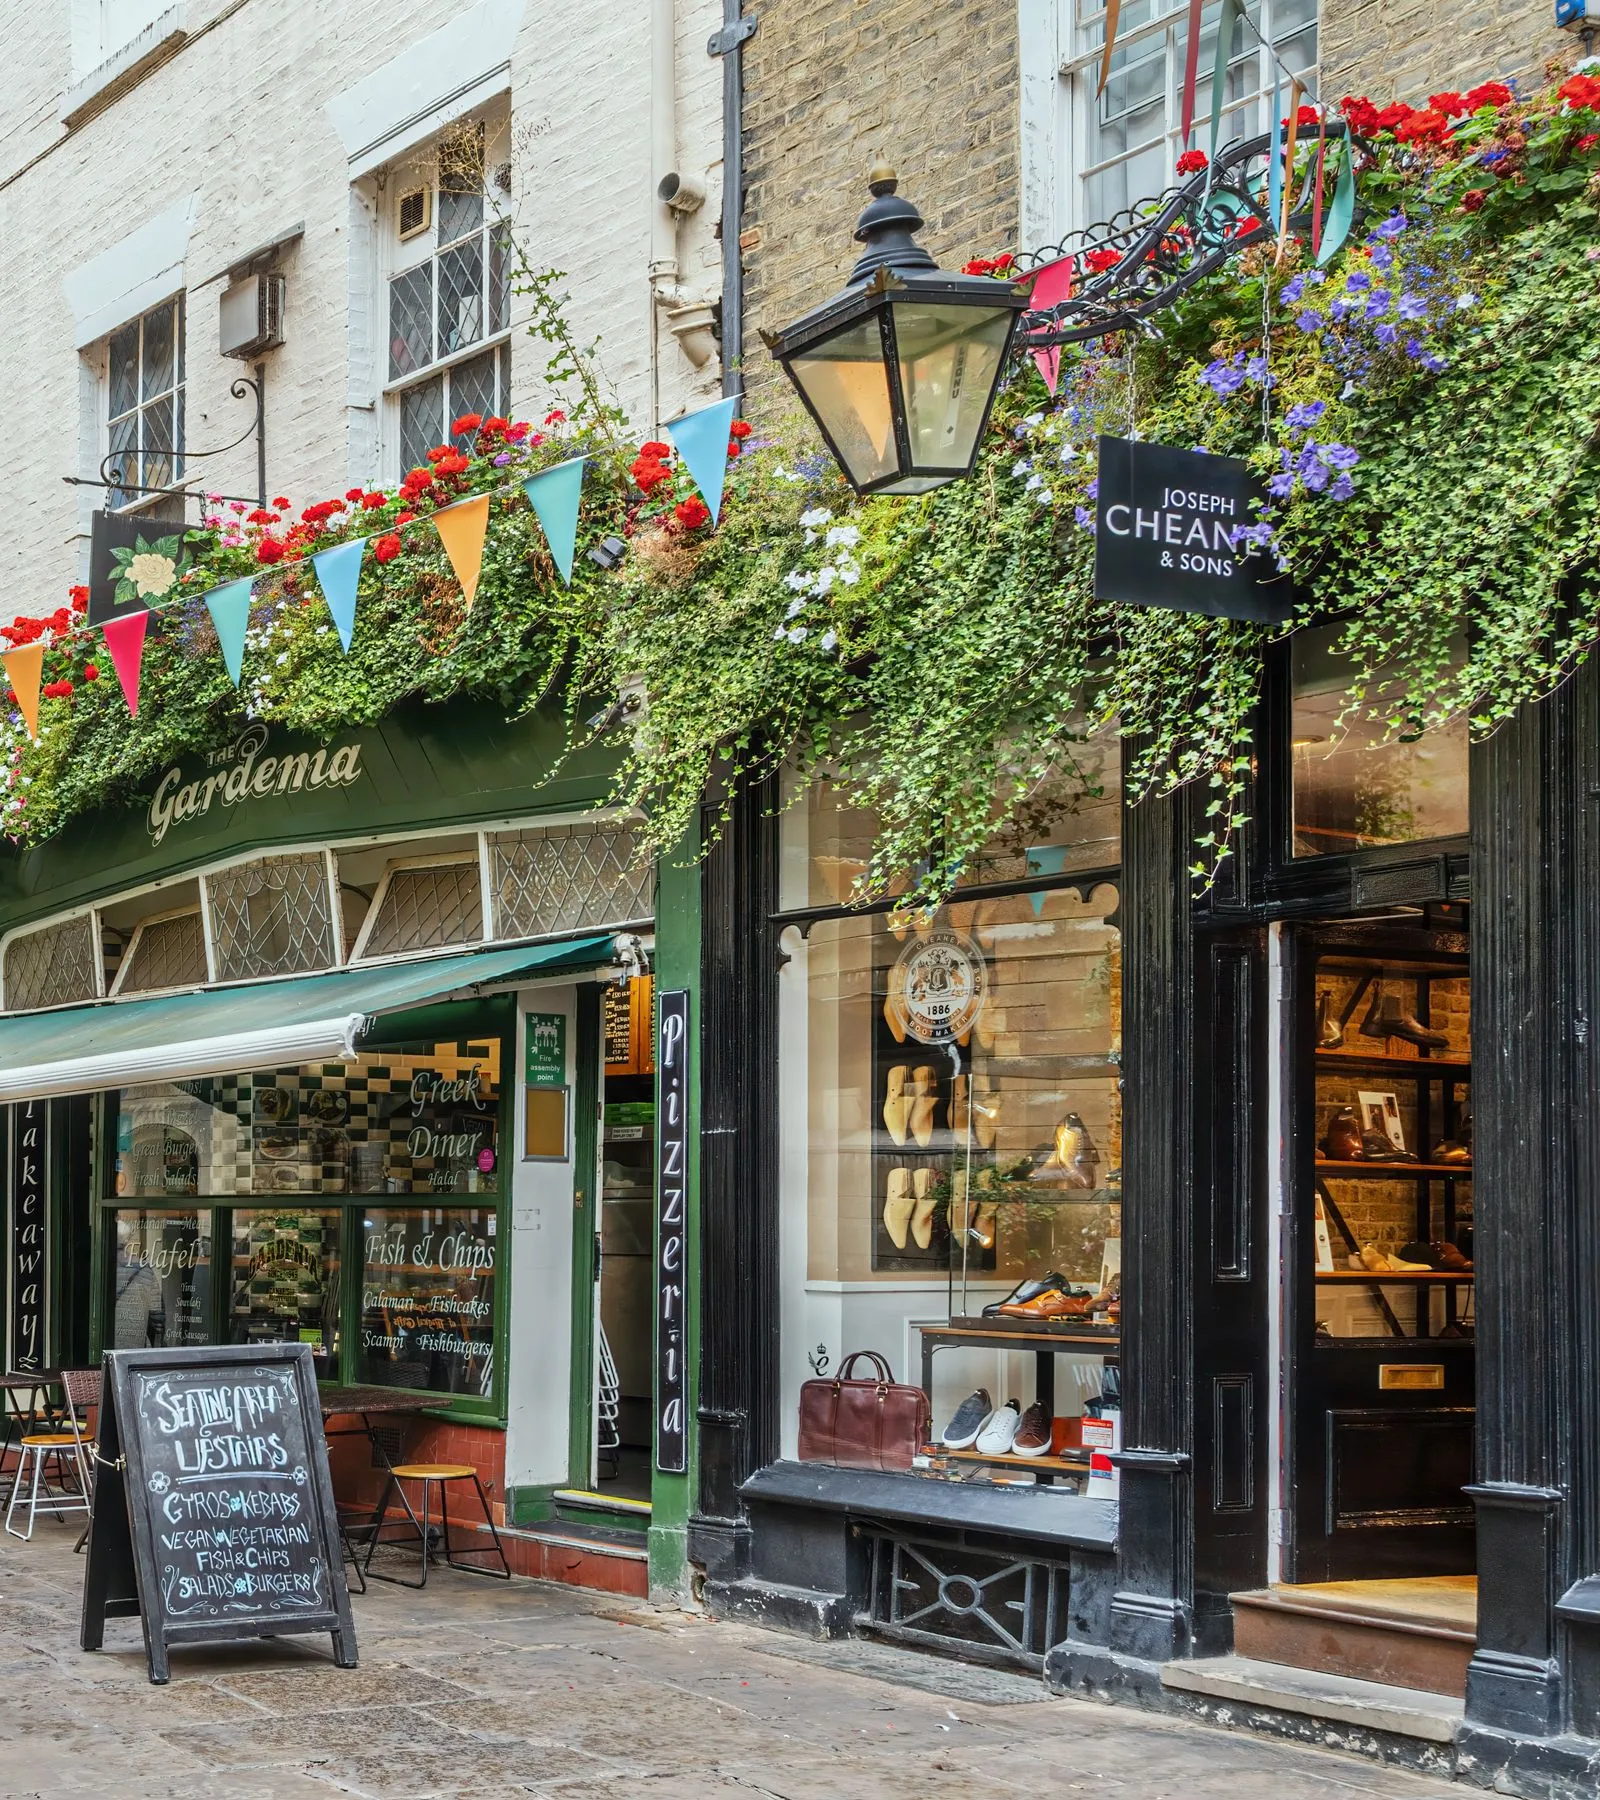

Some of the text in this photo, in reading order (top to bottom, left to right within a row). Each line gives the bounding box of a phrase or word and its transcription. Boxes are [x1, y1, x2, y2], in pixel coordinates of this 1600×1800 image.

[1162, 487, 1235, 516] JOSEPH
[1105, 504, 1262, 558] CHEAN
[1160, 551, 1233, 576] & SONS
[206, 744, 236, 769] THE
[147, 726, 363, 847] Gardenia
[927, 1004, 951, 1016] 1886
[530, 1064, 561, 1073] assembly
[539, 1054, 552, 1062] Fire
[410, 1063, 486, 1118] Greek
[133, 1139, 204, 1163] Great Burgers
[407, 1123, 483, 1159] Diner
[135, 1167, 160, 1187] Fresh
[428, 1170, 459, 1187] Halal
[661, 1013, 683, 1435] Pizzeria
[124, 1237, 202, 1279] Felafel
[249, 1239, 322, 1287] GARDENIA
[365, 1230, 496, 1281] Fish & Chips
[363, 1290, 416, 1311] Calamari
[428, 1294, 490, 1319] Fishcakes
[165, 1328, 209, 1343] Greek Sausages
[363, 1330, 490, 1360] Scampi Fishburgers
[156, 1383, 284, 1437] SEATING AREA
[162, 1490, 301, 1524] GYROS KEBABS
[161, 1523, 310, 1550] VEGAN VEGETARIAN
[196, 1549, 234, 1572] FISH
[234, 1552, 246, 1567] &
[178, 1571, 312, 1599] SALADS BURGERS
